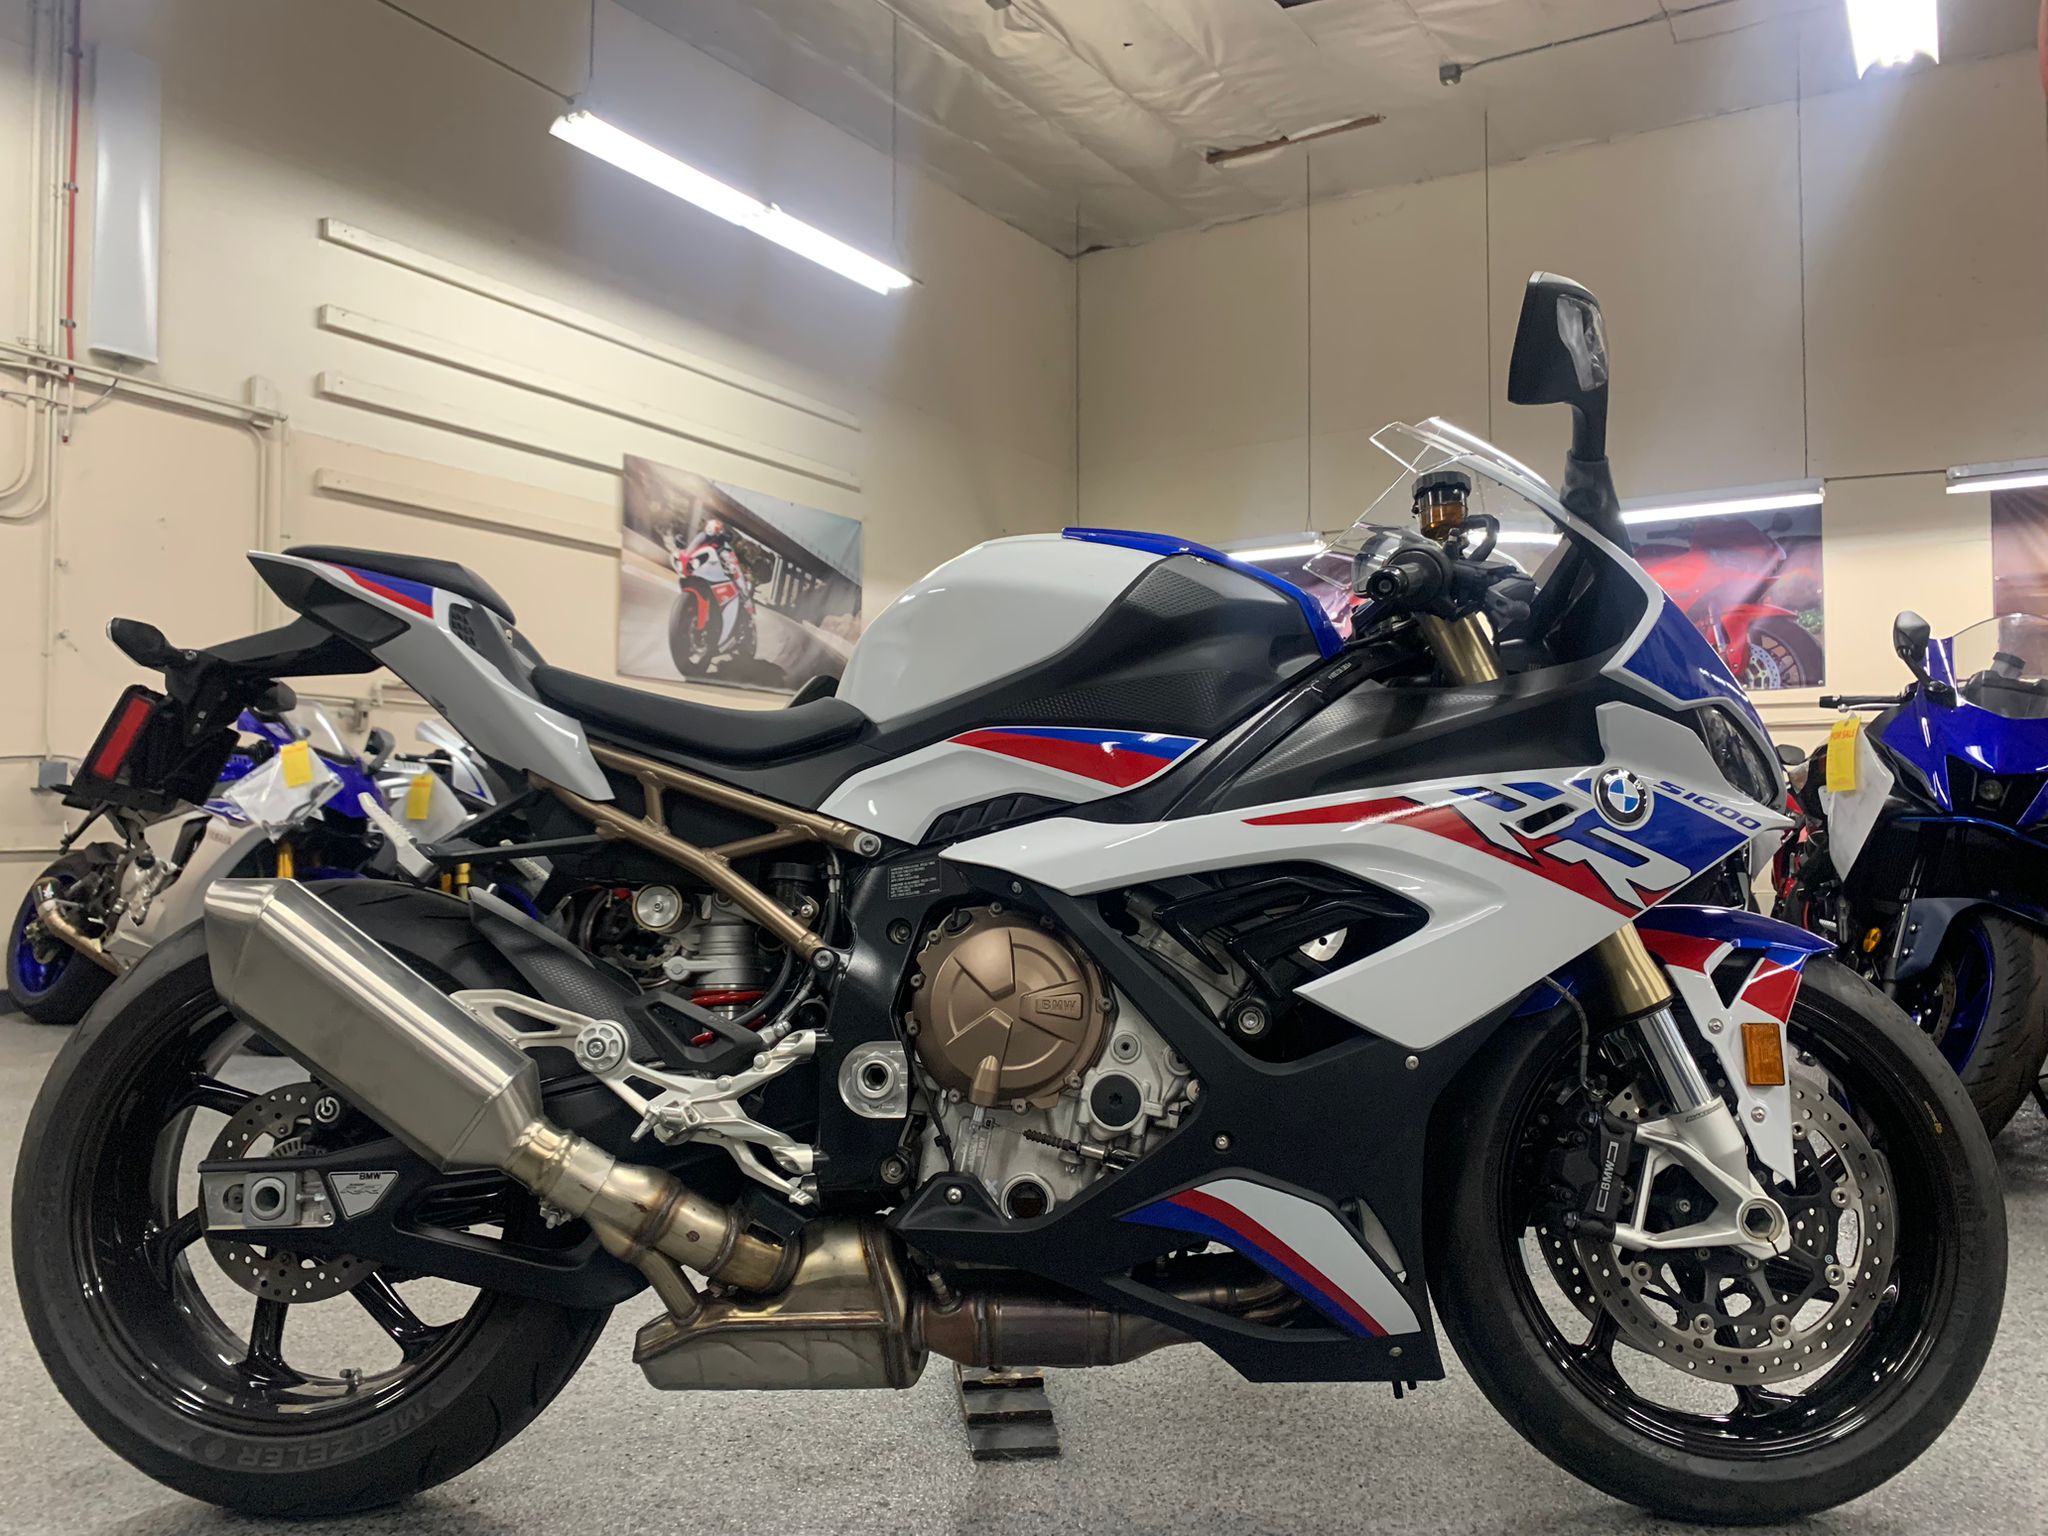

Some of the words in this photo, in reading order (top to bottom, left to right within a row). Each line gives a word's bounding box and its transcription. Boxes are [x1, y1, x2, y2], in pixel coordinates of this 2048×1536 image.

[1653, 780, 1762, 831] S1000
[1041, 999, 1077, 1010] BMW
[359, 1172, 381, 1180] BMW
[1600, 1159, 1615, 1191] BMW
[236, 1404, 428, 1468] METZELER
